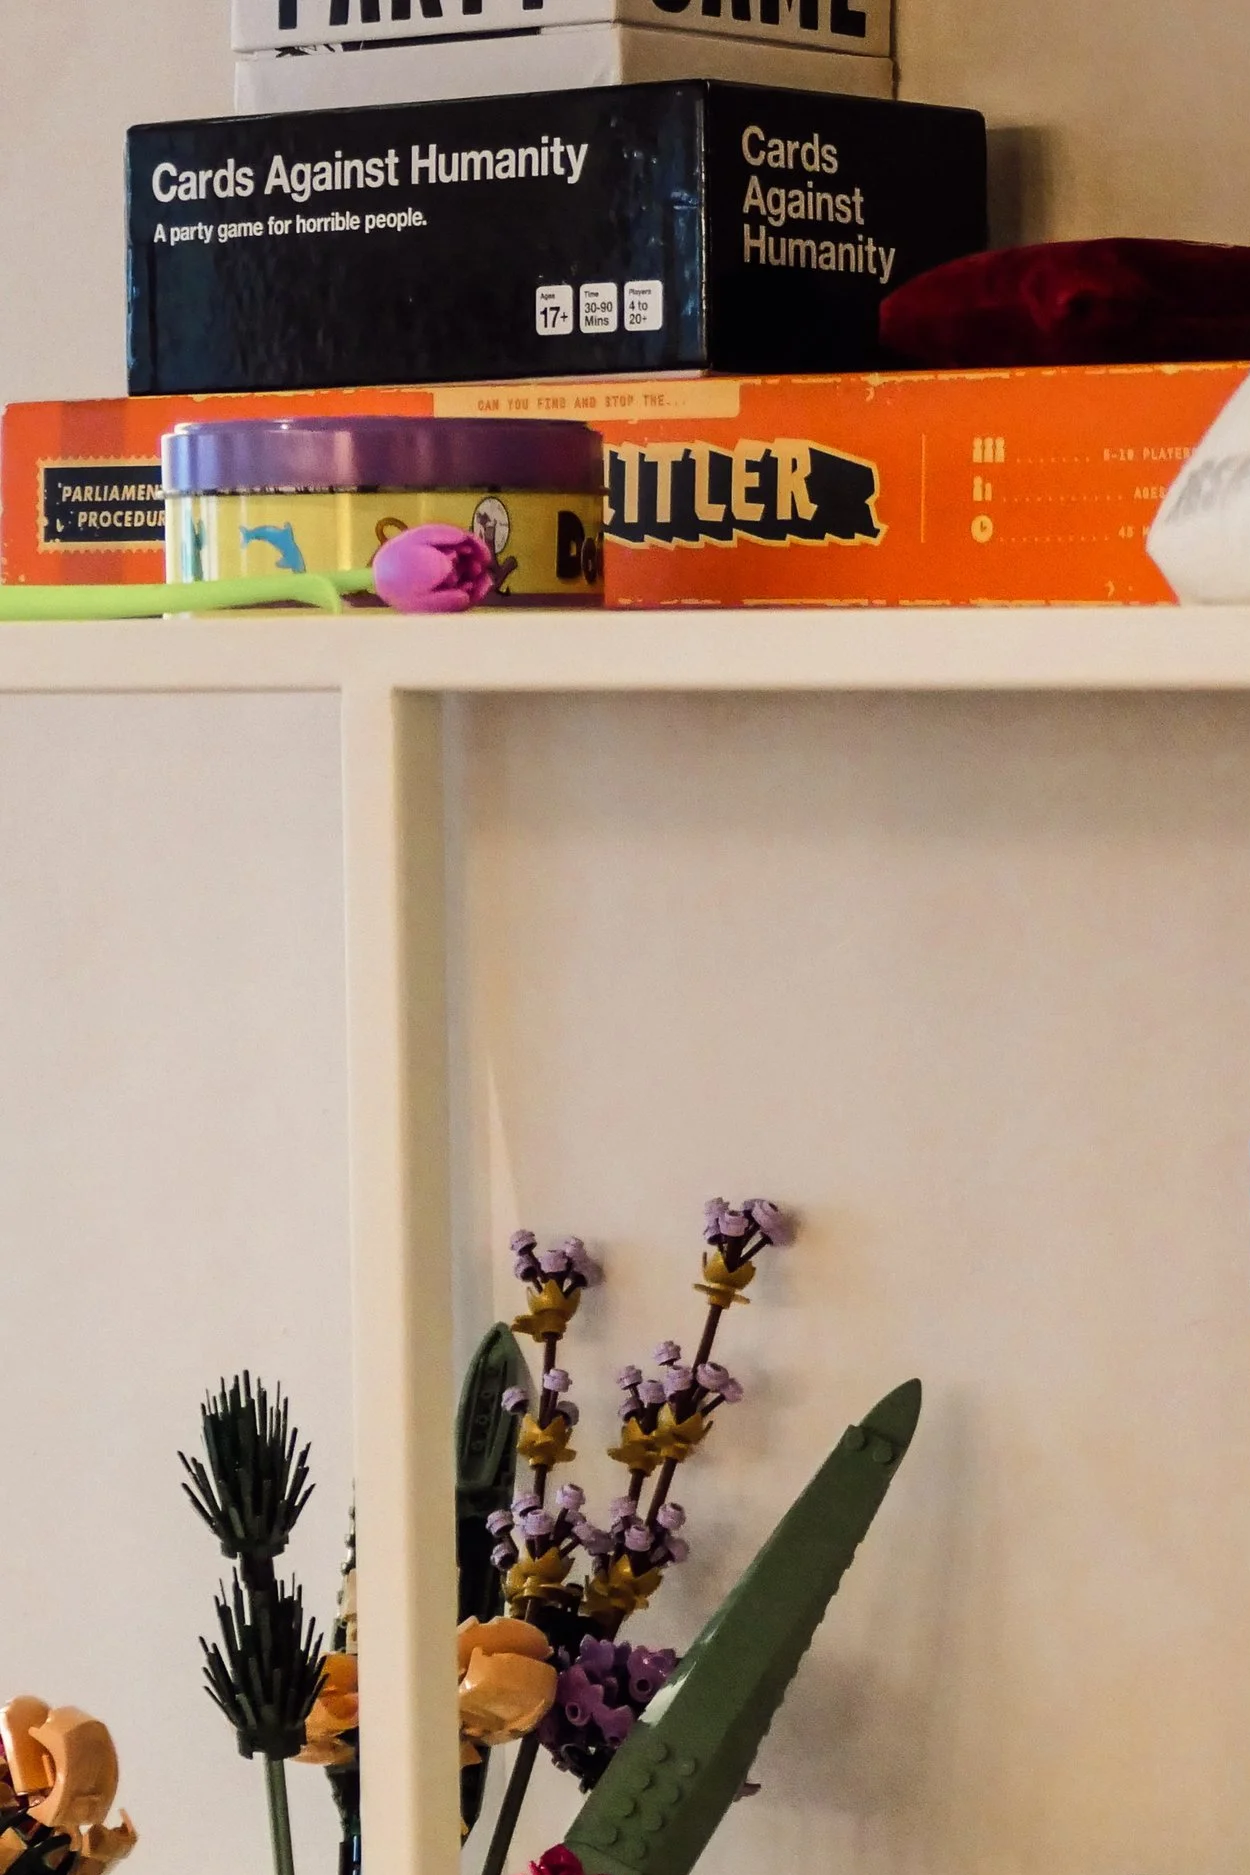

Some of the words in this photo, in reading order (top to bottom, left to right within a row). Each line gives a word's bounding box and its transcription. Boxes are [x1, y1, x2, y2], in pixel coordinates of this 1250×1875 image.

[741, 125, 839, 174] Cards
[152, 159, 254, 203] Cards
[264, 148, 400, 203] Against
[410, 135, 588, 185] Humanity
[743, 175, 865, 228] Against
[153, 225, 166, 243] A
[169, 222, 214, 246] party
[217, 220, 263, 243] game
[267, 215, 293, 236] for
[296, 210, 360, 235] horrible
[364, 207, 428, 232] people.
[743, 223, 896, 284] Humanity
[584, 301, 613, 314] 30-90
[629, 301, 635, 311] 4
[637, 301, 648, 311] to
[540, 306, 568, 328] 17+
[584, 315, 610, 327] Mins
[629, 314, 647, 325] 20+
[477, 400, 500, 412] CAN
[507, 398, 529, 411] YOU
[573, 396, 597, 409] AND
[605, 395, 635, 408] STOP
[62, 484, 162, 502] PARLIAMEN
[78, 510, 166, 528] PROCEDUR
